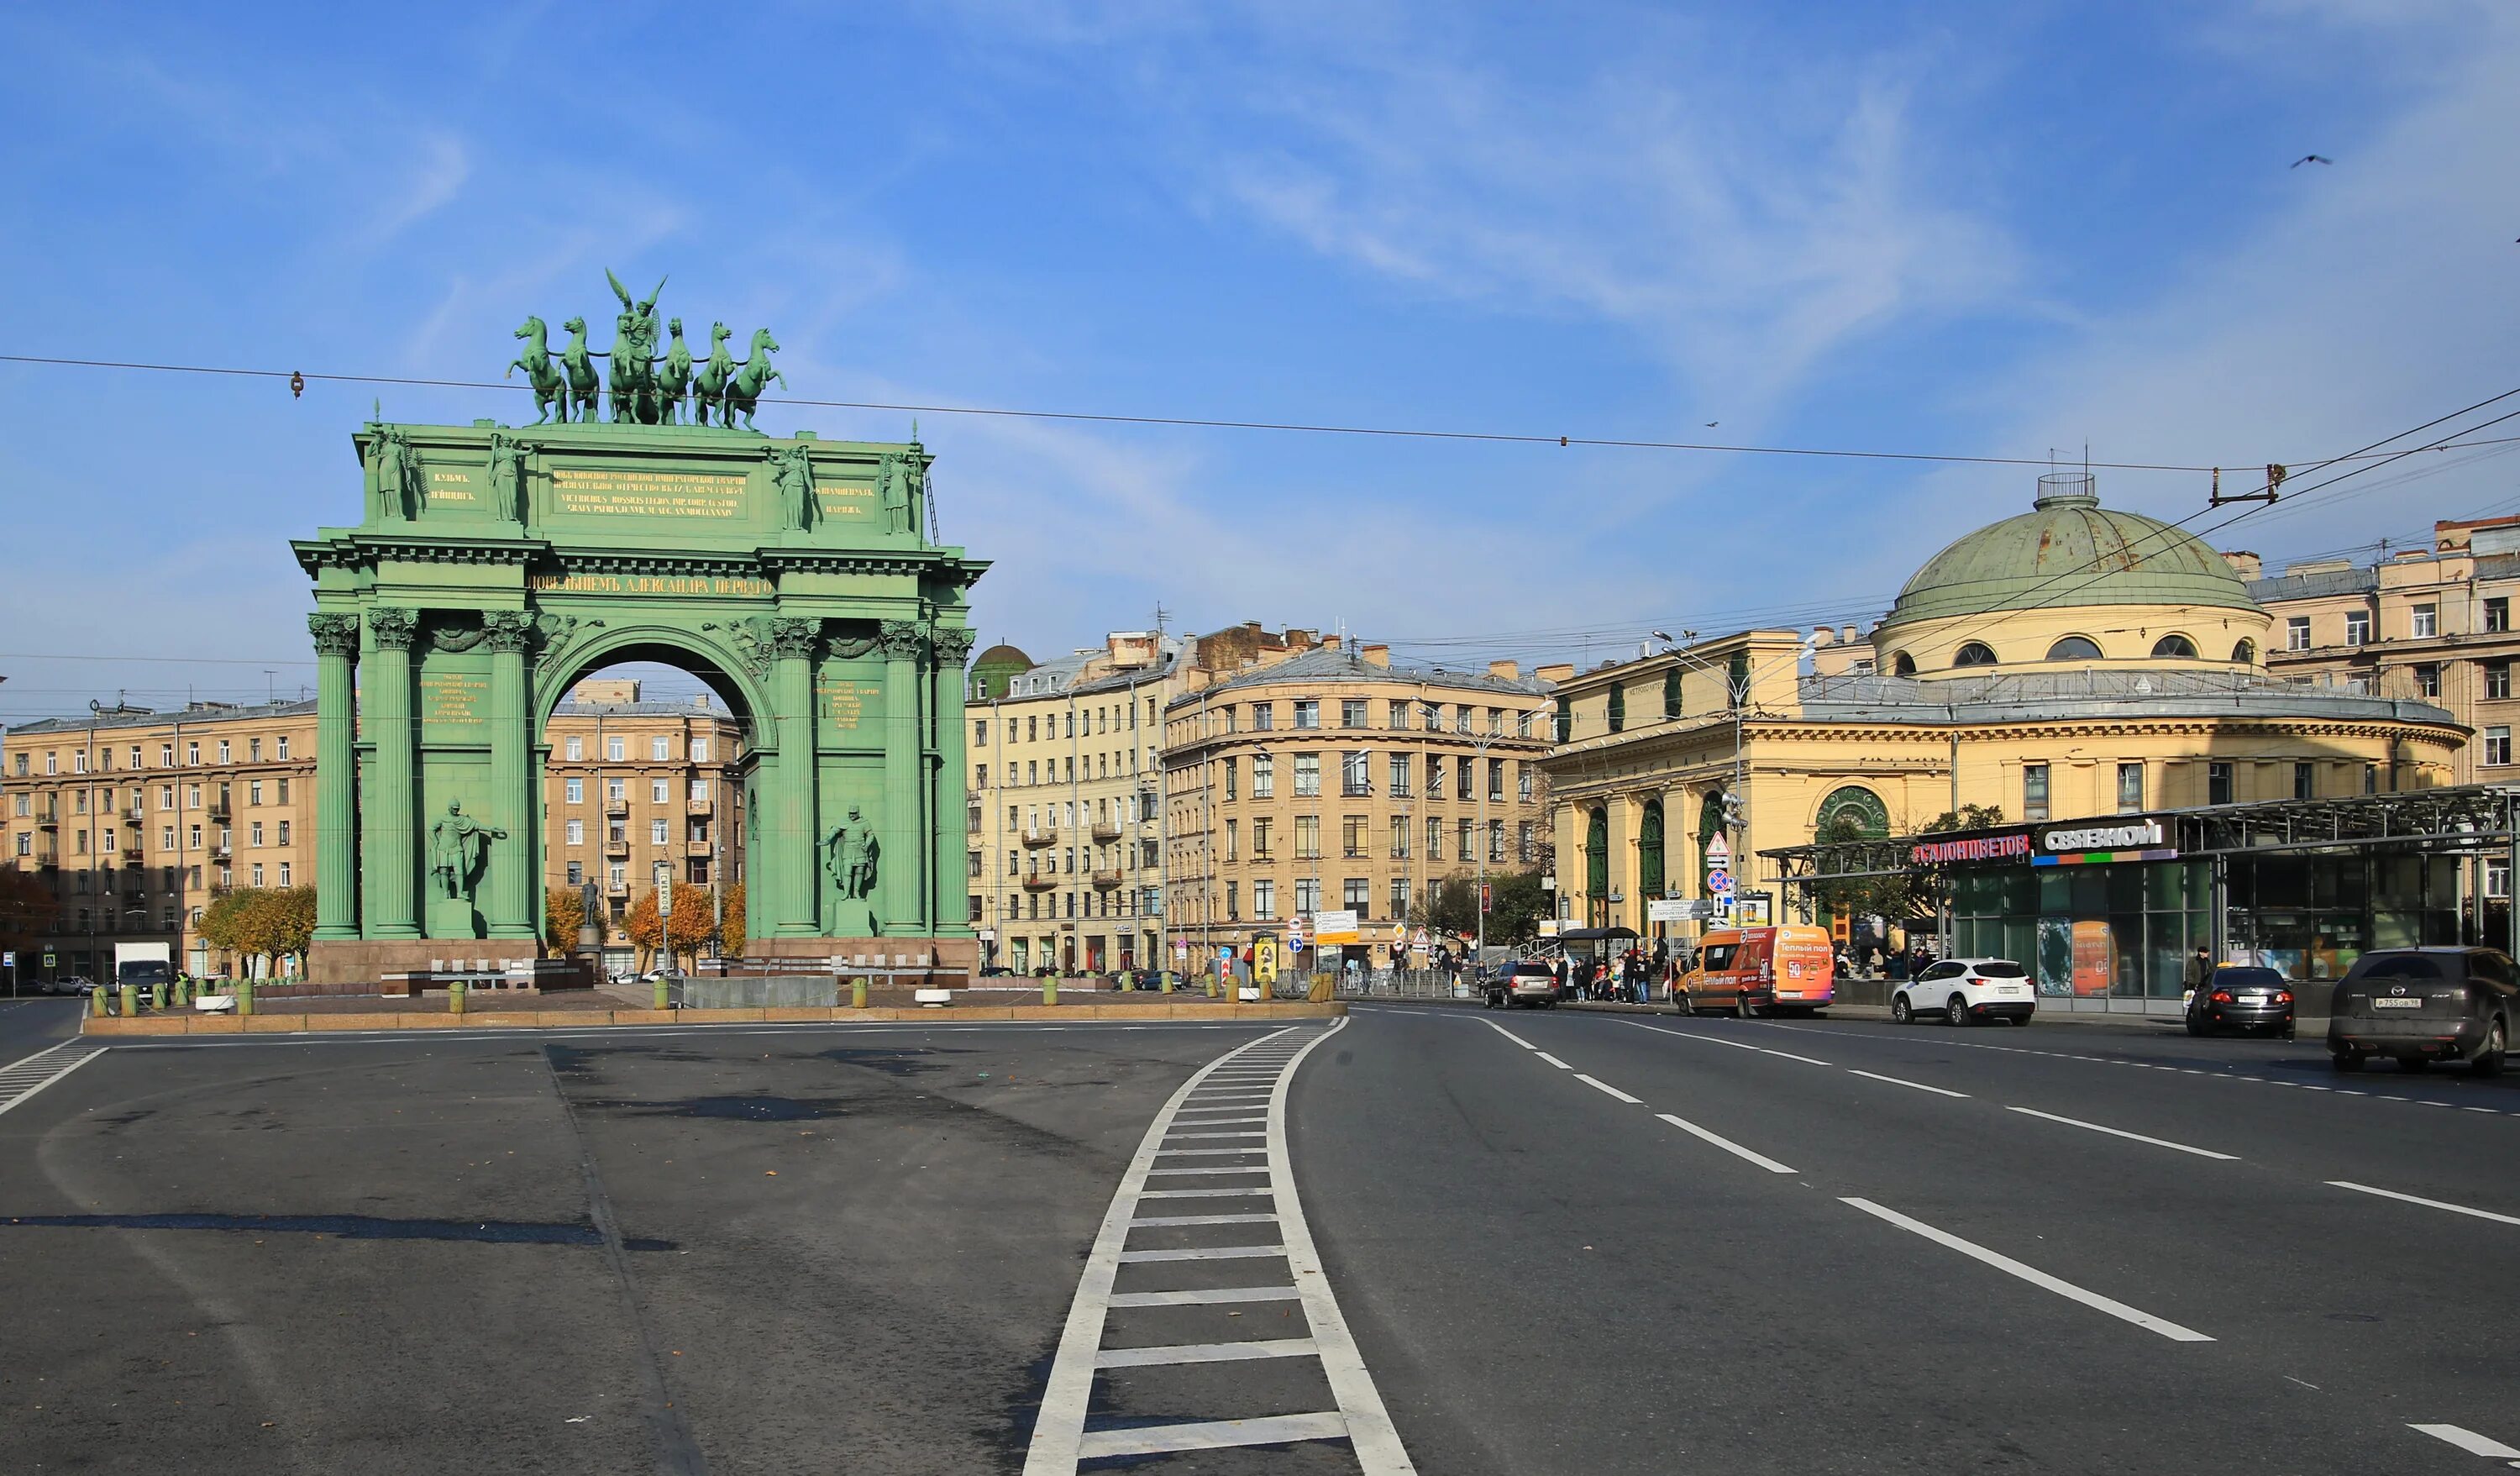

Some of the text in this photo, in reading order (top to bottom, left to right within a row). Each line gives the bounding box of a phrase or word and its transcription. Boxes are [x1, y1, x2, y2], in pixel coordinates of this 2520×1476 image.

[626, 578, 709, 594] АЛЕКСАНДРА
[715, 579, 773, 595] ПЕРВАГО
[2045, 818, 2162, 852] СВЯЗНОЙ
[1780, 943, 1812, 952] Теплый
[1760, 959, 1768, 979] 50
[1788, 962, 1800, 975] 50
[1703, 973, 1724, 985] Теплый
[1725, 975, 1736, 985] пол
